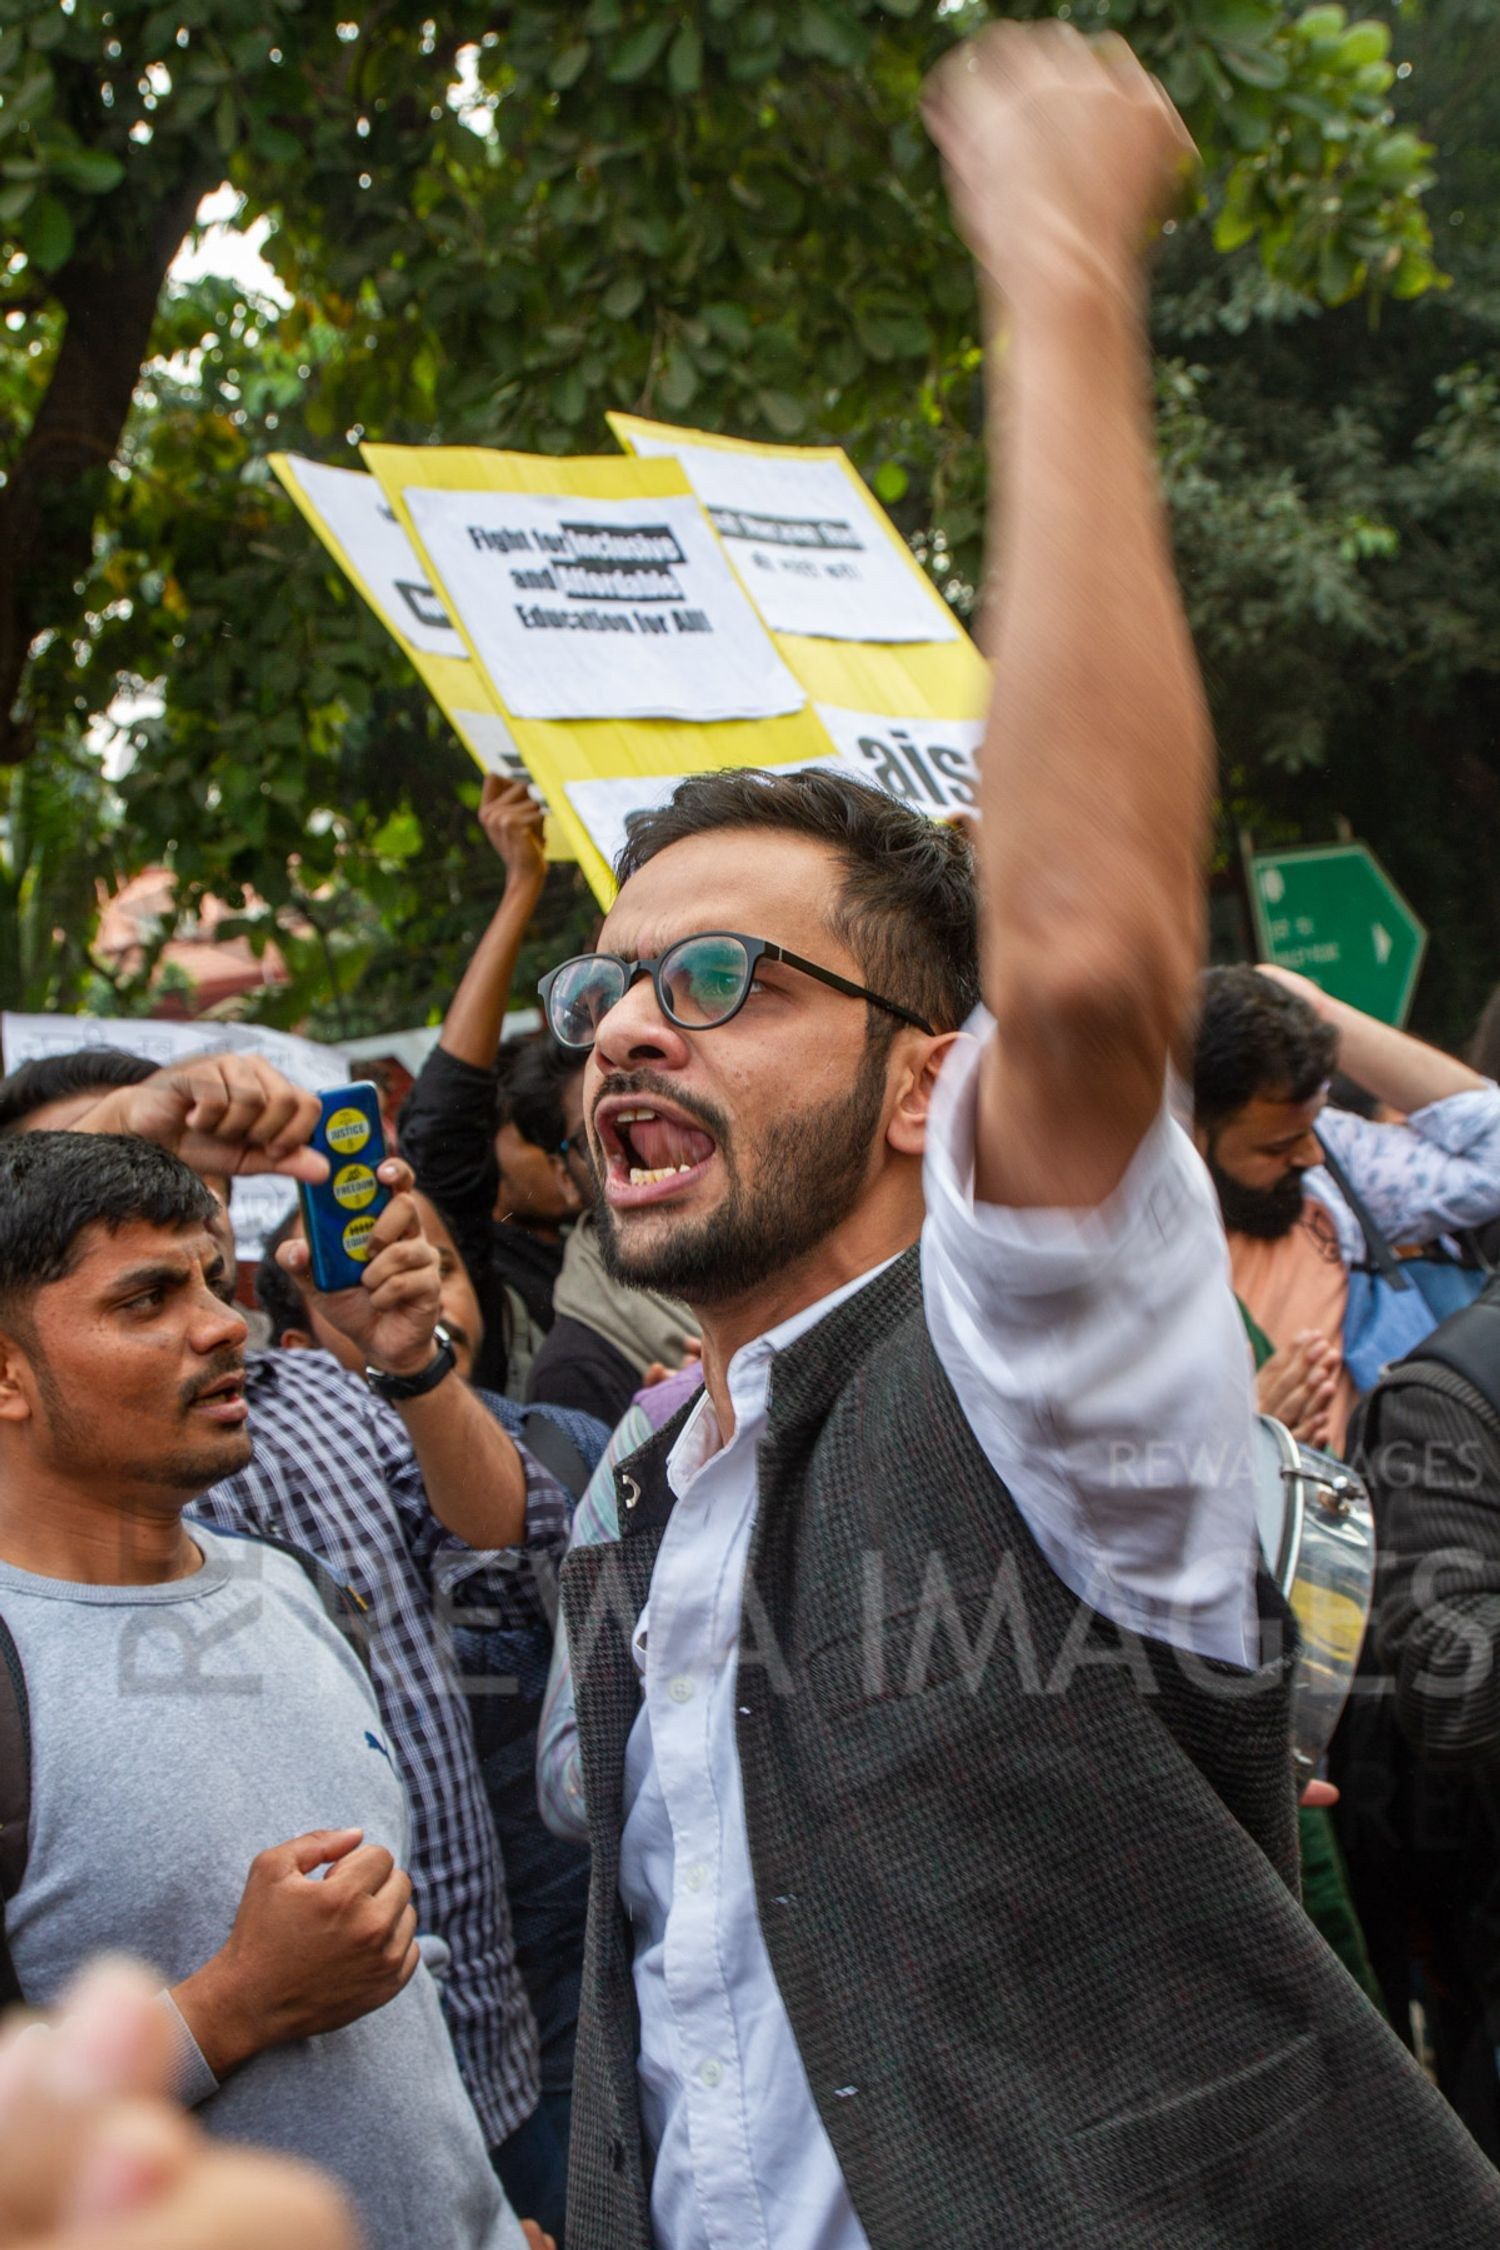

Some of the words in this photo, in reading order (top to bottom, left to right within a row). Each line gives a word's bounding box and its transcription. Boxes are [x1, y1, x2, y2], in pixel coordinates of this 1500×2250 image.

[467, 525, 533, 553] Fight
[532, 529, 566, 552] for
[510, 568, 557, 590] and
[515, 605, 634, 632] Education
[634, 610, 669, 633] for
[857, 730, 982, 806] ais
[331, 1124, 365, 1141] JUSTICE
[336, 1179, 375, 1197] FREEDOM
